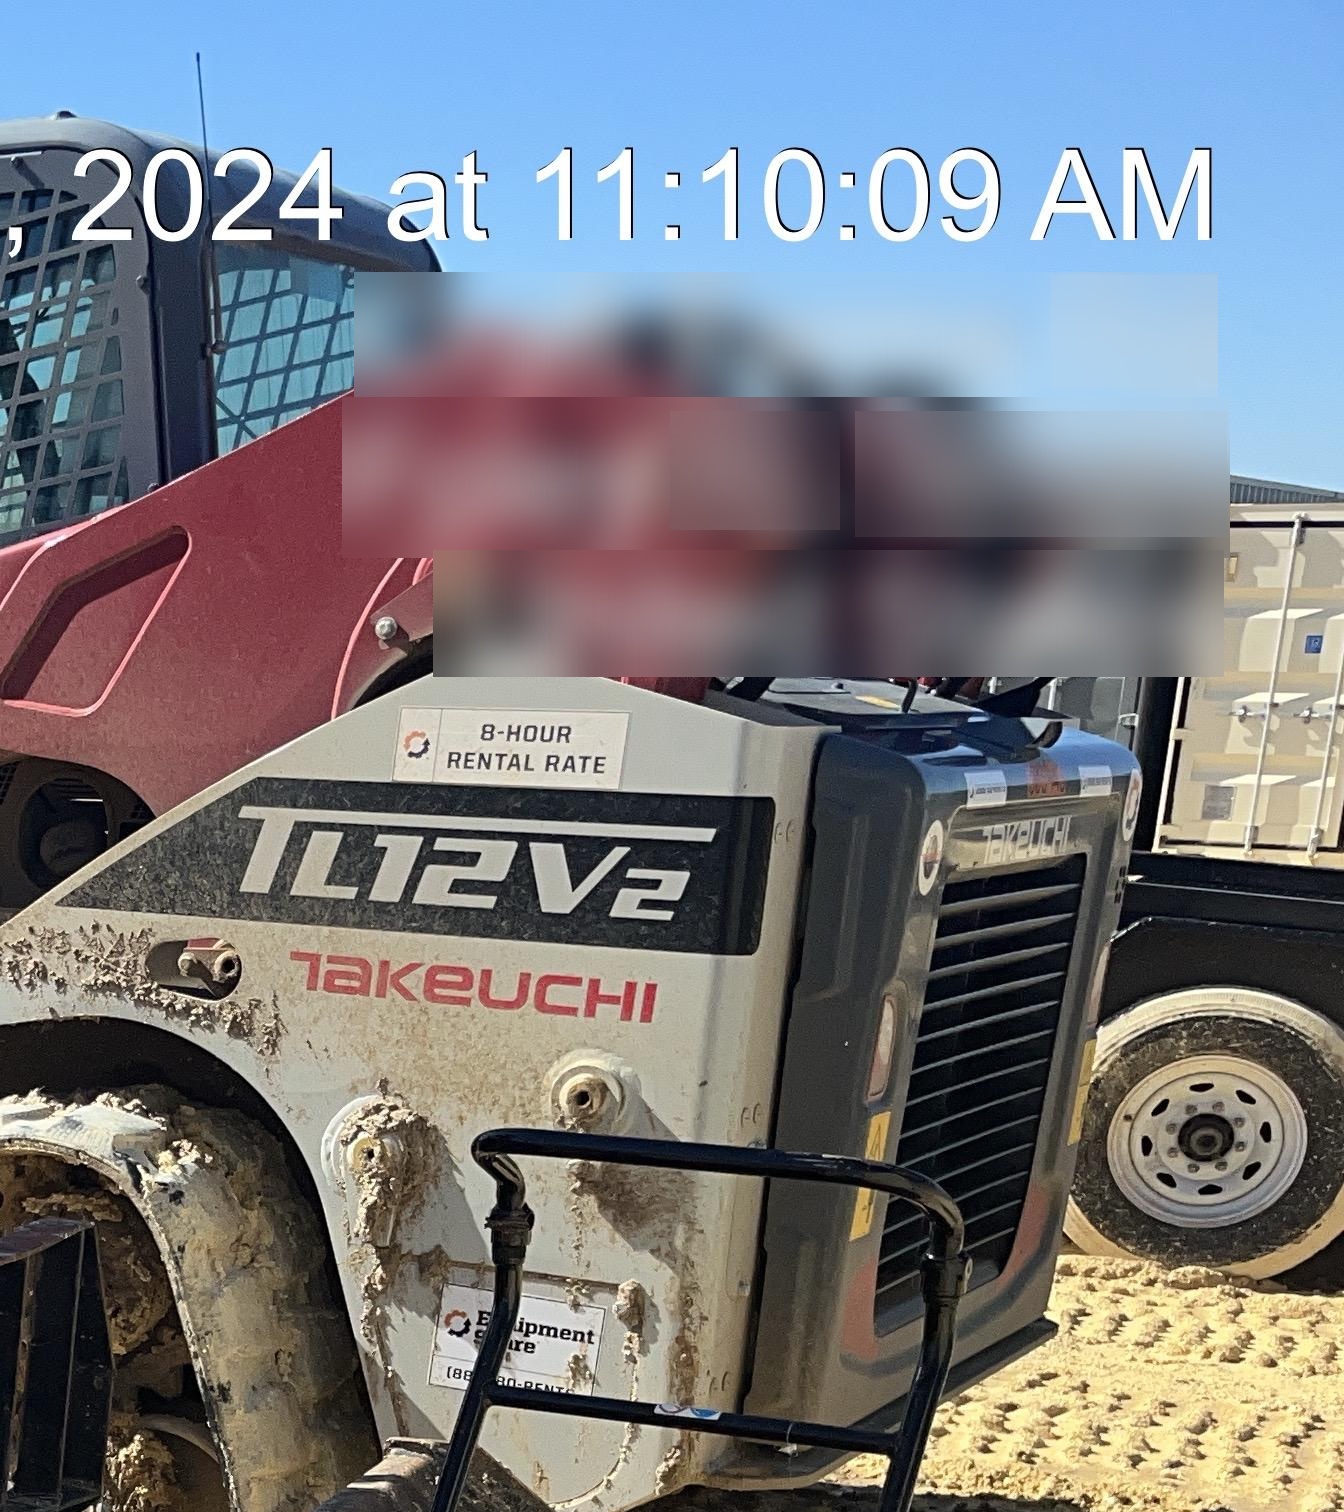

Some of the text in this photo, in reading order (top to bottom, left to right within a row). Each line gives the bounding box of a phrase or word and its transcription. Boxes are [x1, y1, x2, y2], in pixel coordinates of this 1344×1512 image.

[480, 723, 572, 744] 8-HOUR
[446, 751, 607, 774] RENTAL RATE
[237, 805, 717, 922] TL12V2
[476, 1309, 595, 1345] Eipment
[473, 1329, 537, 1354] Sre
